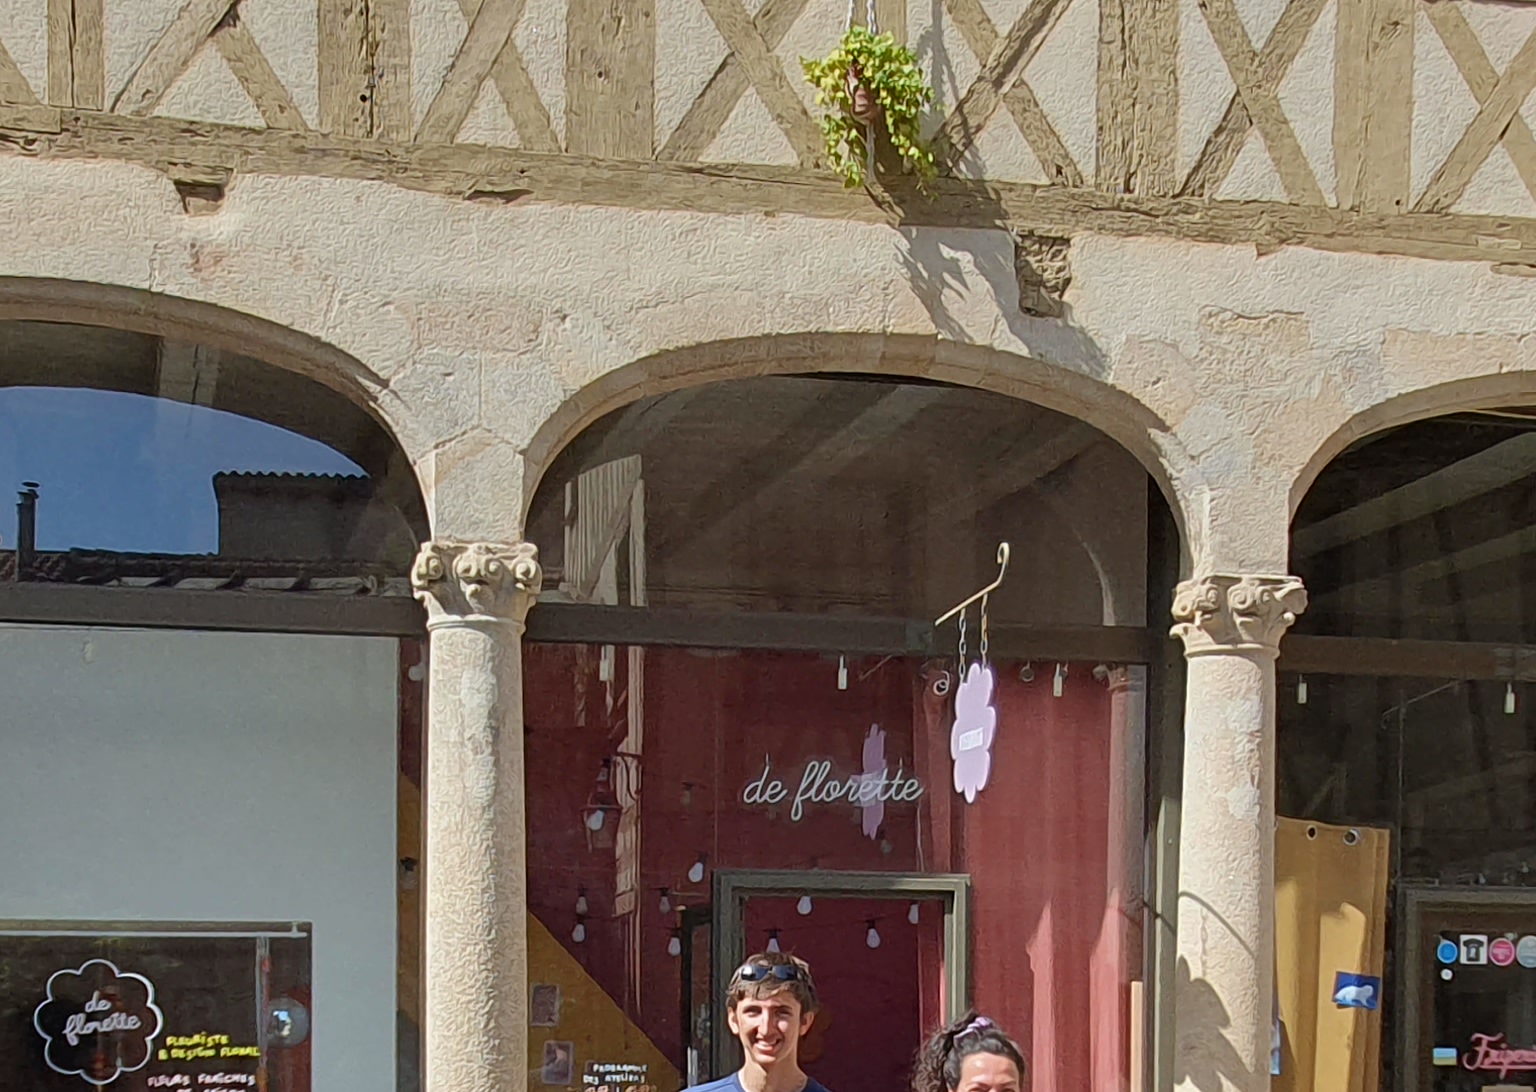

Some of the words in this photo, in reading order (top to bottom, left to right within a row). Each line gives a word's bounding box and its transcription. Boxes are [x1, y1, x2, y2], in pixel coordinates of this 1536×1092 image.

[743, 765, 788, 803] de
[791, 760, 924, 821] florette
[85, 990, 112, 1013] de
[62, 1012, 142, 1047] florette
